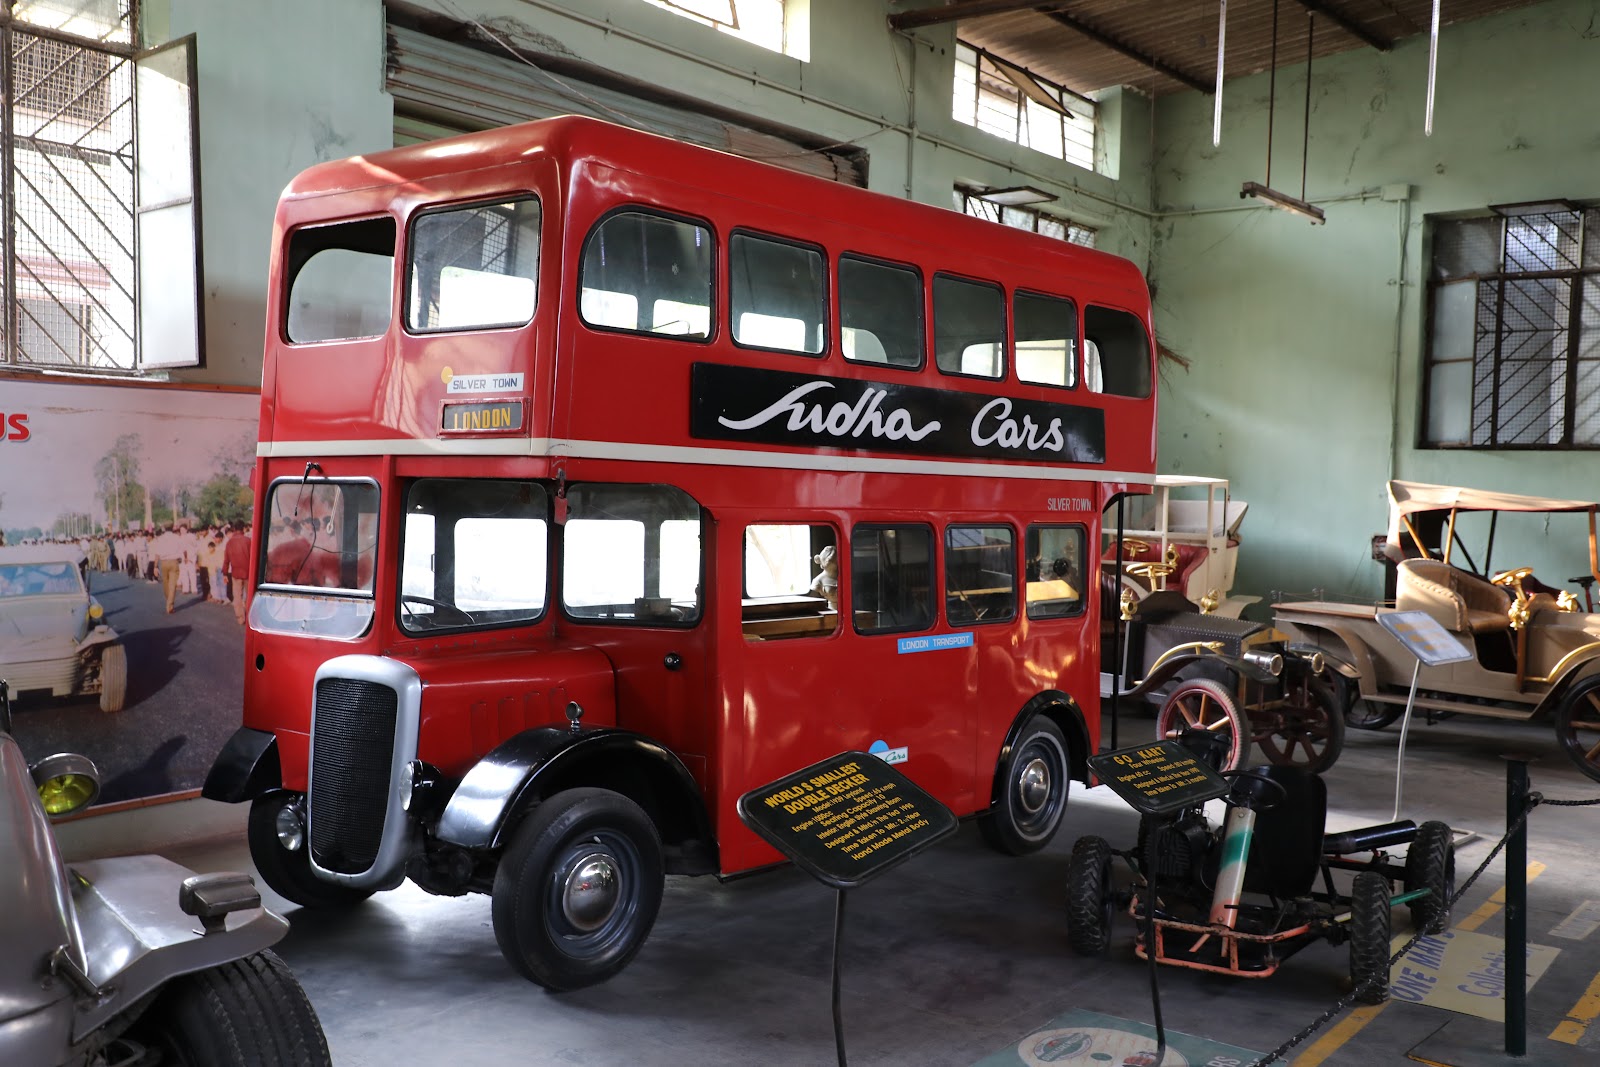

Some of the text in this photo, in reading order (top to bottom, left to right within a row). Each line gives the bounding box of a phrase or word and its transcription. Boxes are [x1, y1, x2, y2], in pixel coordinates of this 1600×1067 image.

[453, 377, 518, 390] SILVER TOWN
[453, 407, 511, 430] LONDON
[717, 380, 1064, 452] Sudha Cars
[1047, 497, 1092, 511] SILVER TOWN
[901, 635, 970, 651] LONDON TRANSPORT
[884, 751, 906, 763] Cars
[1113, 746, 1166, 765] GO KART
[809, 762, 861, 788] SMALLEST
[783, 773, 870, 815] DOUBLE DECKER
[885, 796, 903, 807] Room
[820, 812, 849, 827] Seating
[846, 798, 878, 815] Capacity
[824, 830, 856, 849] Designed
[875, 814, 889, 823] The
[841, 842, 860, 853] Time
[856, 832, 878, 845] Taken
[874, 828, 886, 836] To
[851, 819, 930, 861] Hand Made Metal Body
[1389, 966, 1438, 1002] ONE
